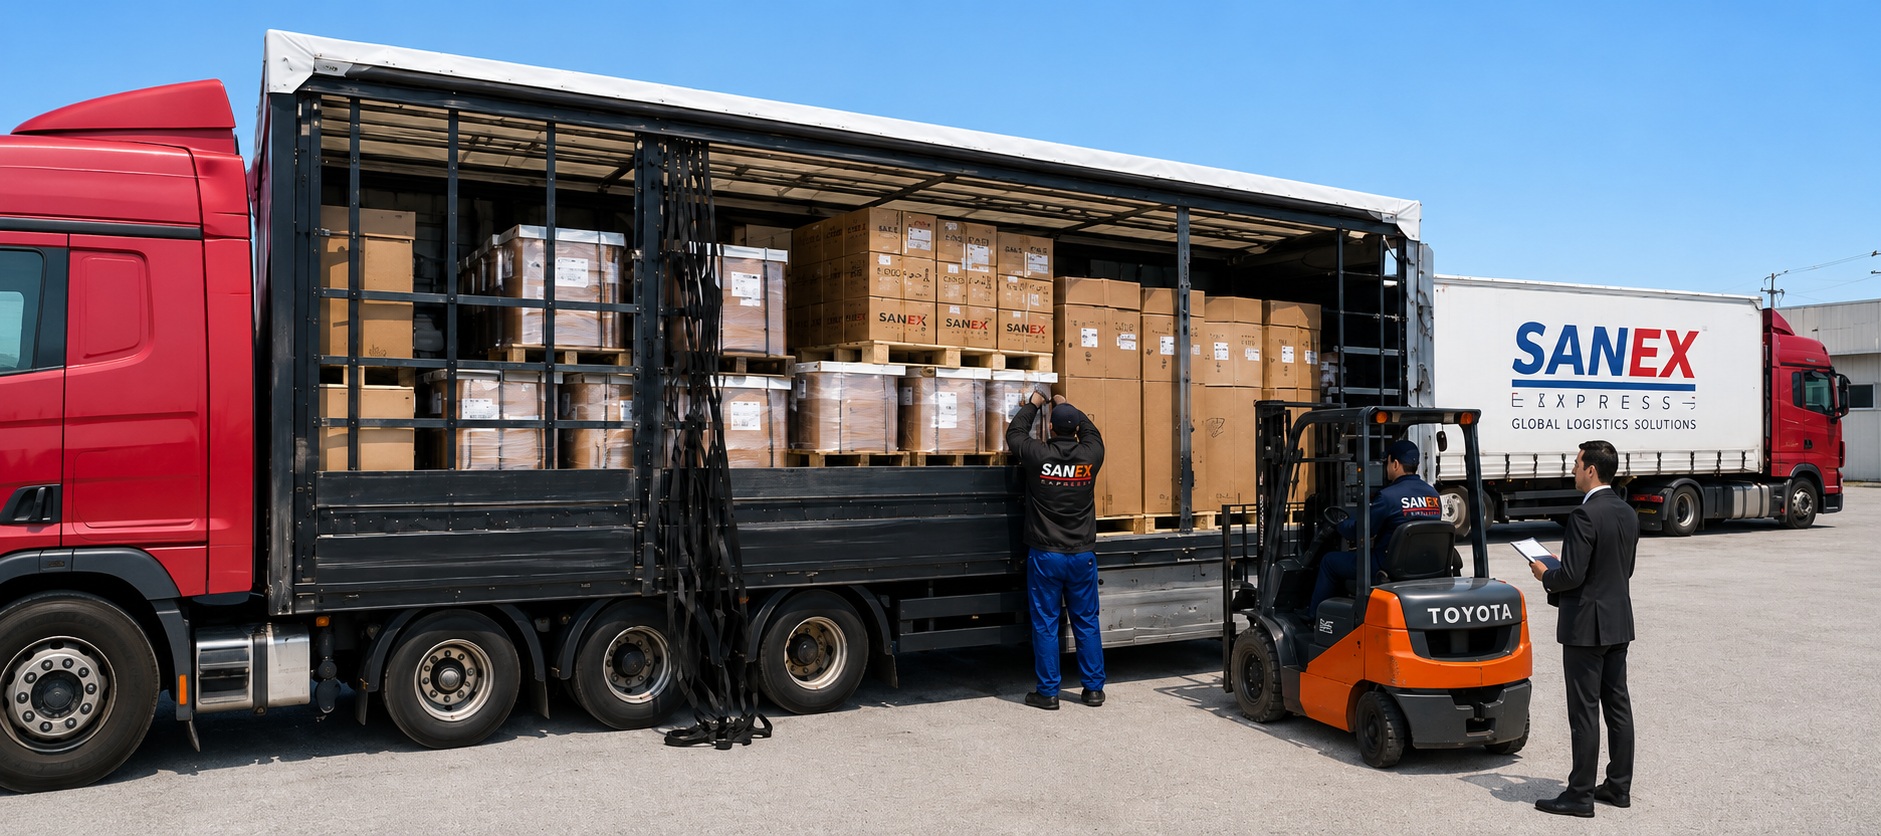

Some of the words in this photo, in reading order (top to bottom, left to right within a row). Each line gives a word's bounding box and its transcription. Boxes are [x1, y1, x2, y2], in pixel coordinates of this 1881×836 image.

[879, 312, 927, 327] SANEX
[945, 318, 988, 330] SANEX
[1006, 323, 1046, 334] SANEX
[1512, 321, 1699, 378] SANEX
[1511, 417, 1560, 430] GLOBAL
[1566, 418, 1629, 430] LOGISTICS
[1634, 418, 1697, 430] SOLUTIONS
[1041, 463, 1093, 477] SANEX
[1401, 496, 1439, 508] SANEX
[1427, 603, 1513, 624] TOYOTA
